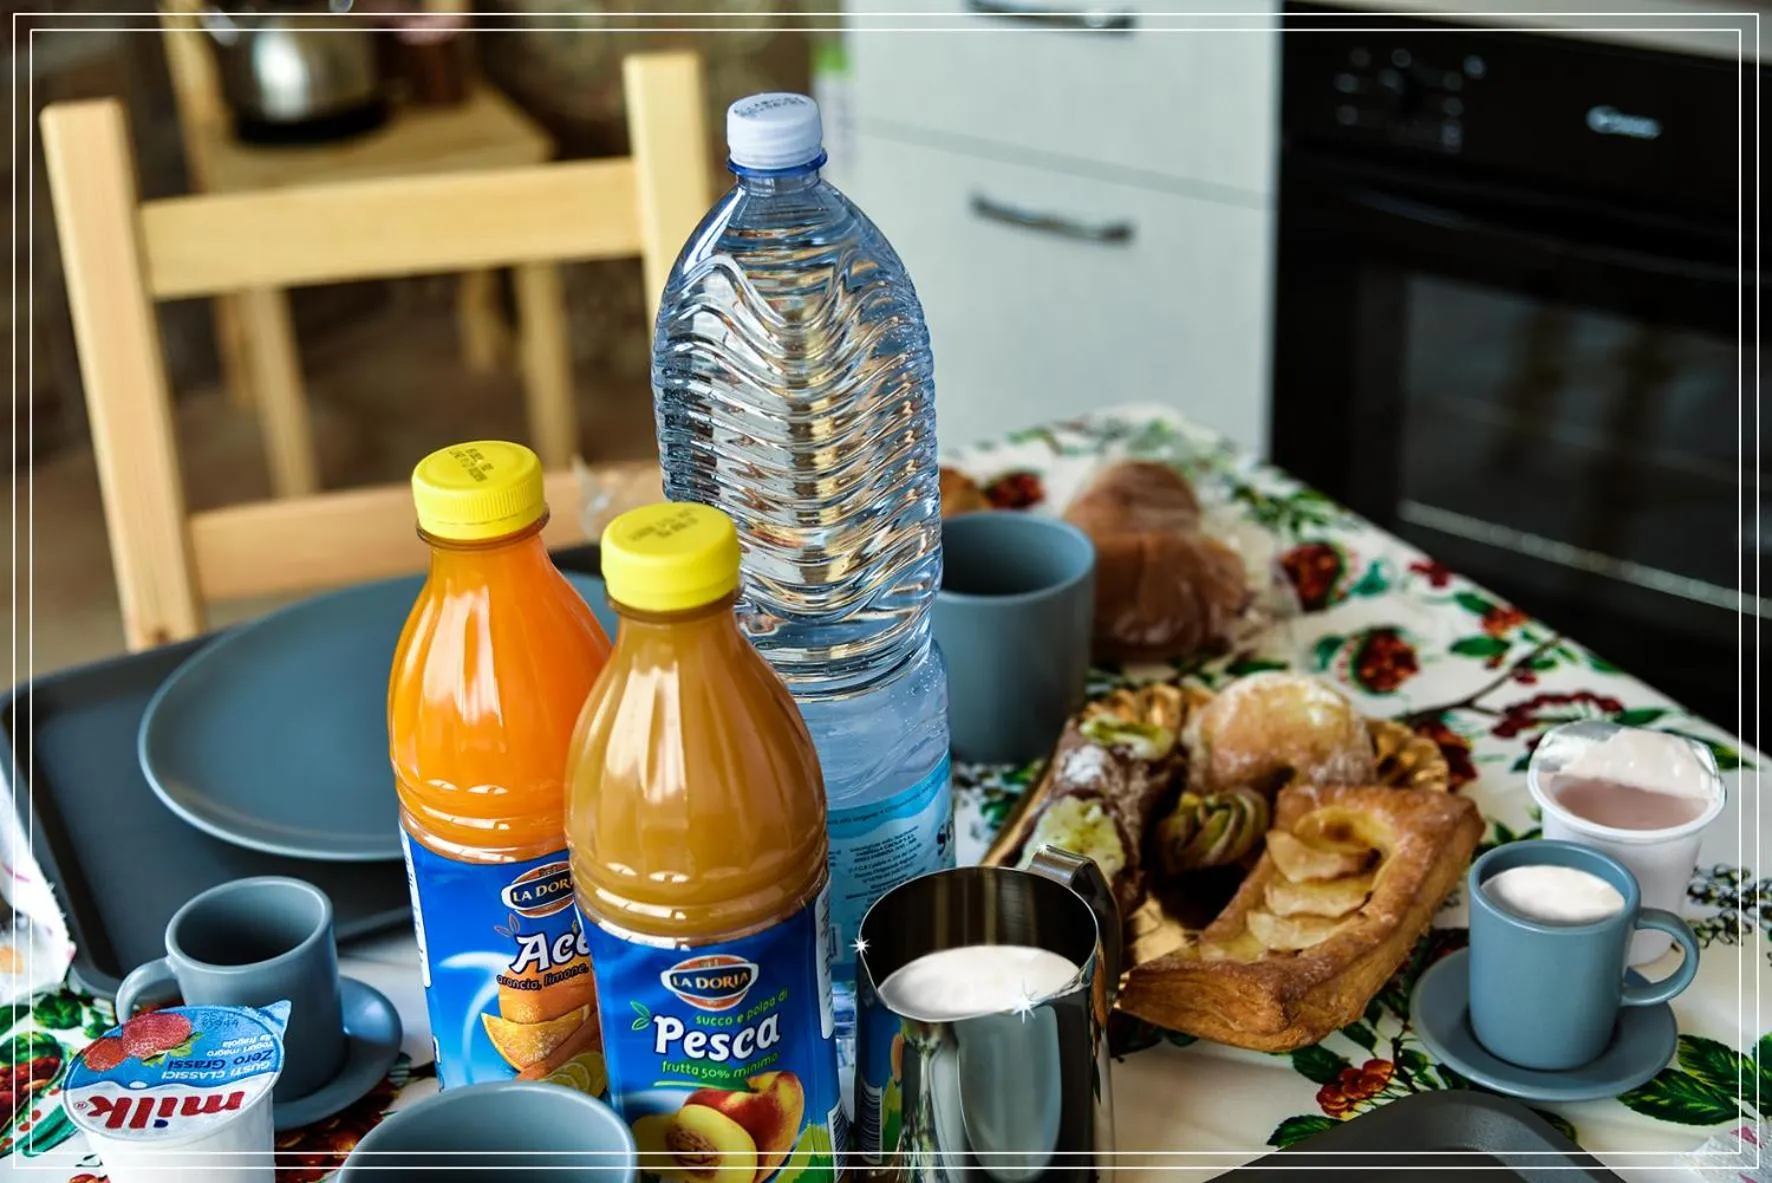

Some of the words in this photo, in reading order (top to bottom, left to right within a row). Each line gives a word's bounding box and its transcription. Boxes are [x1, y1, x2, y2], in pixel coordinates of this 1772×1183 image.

[512, 890, 533, 903] LA
[535, 878, 575, 898] DOR
[671, 975, 693, 989] LA
[694, 971, 750, 990] DORIA
[696, 1014, 733, 1026] succo
[737, 1013, 745, 1024] e
[746, 996, 776, 1021] polpa
[653, 1012, 781, 1062] Pesca
[167, 1058, 227, 1072] Grassi
[233, 1049, 275, 1066] Zero
[662, 1060, 700, 1076] frutta
[701, 1067, 731, 1079] 50%
[733, 1053, 779, 1078] minimo
[161, 1070, 226, 1080] CLASSICI
[230, 1060, 271, 1078] GUSTI
[87, 1090, 246, 1131] milk
